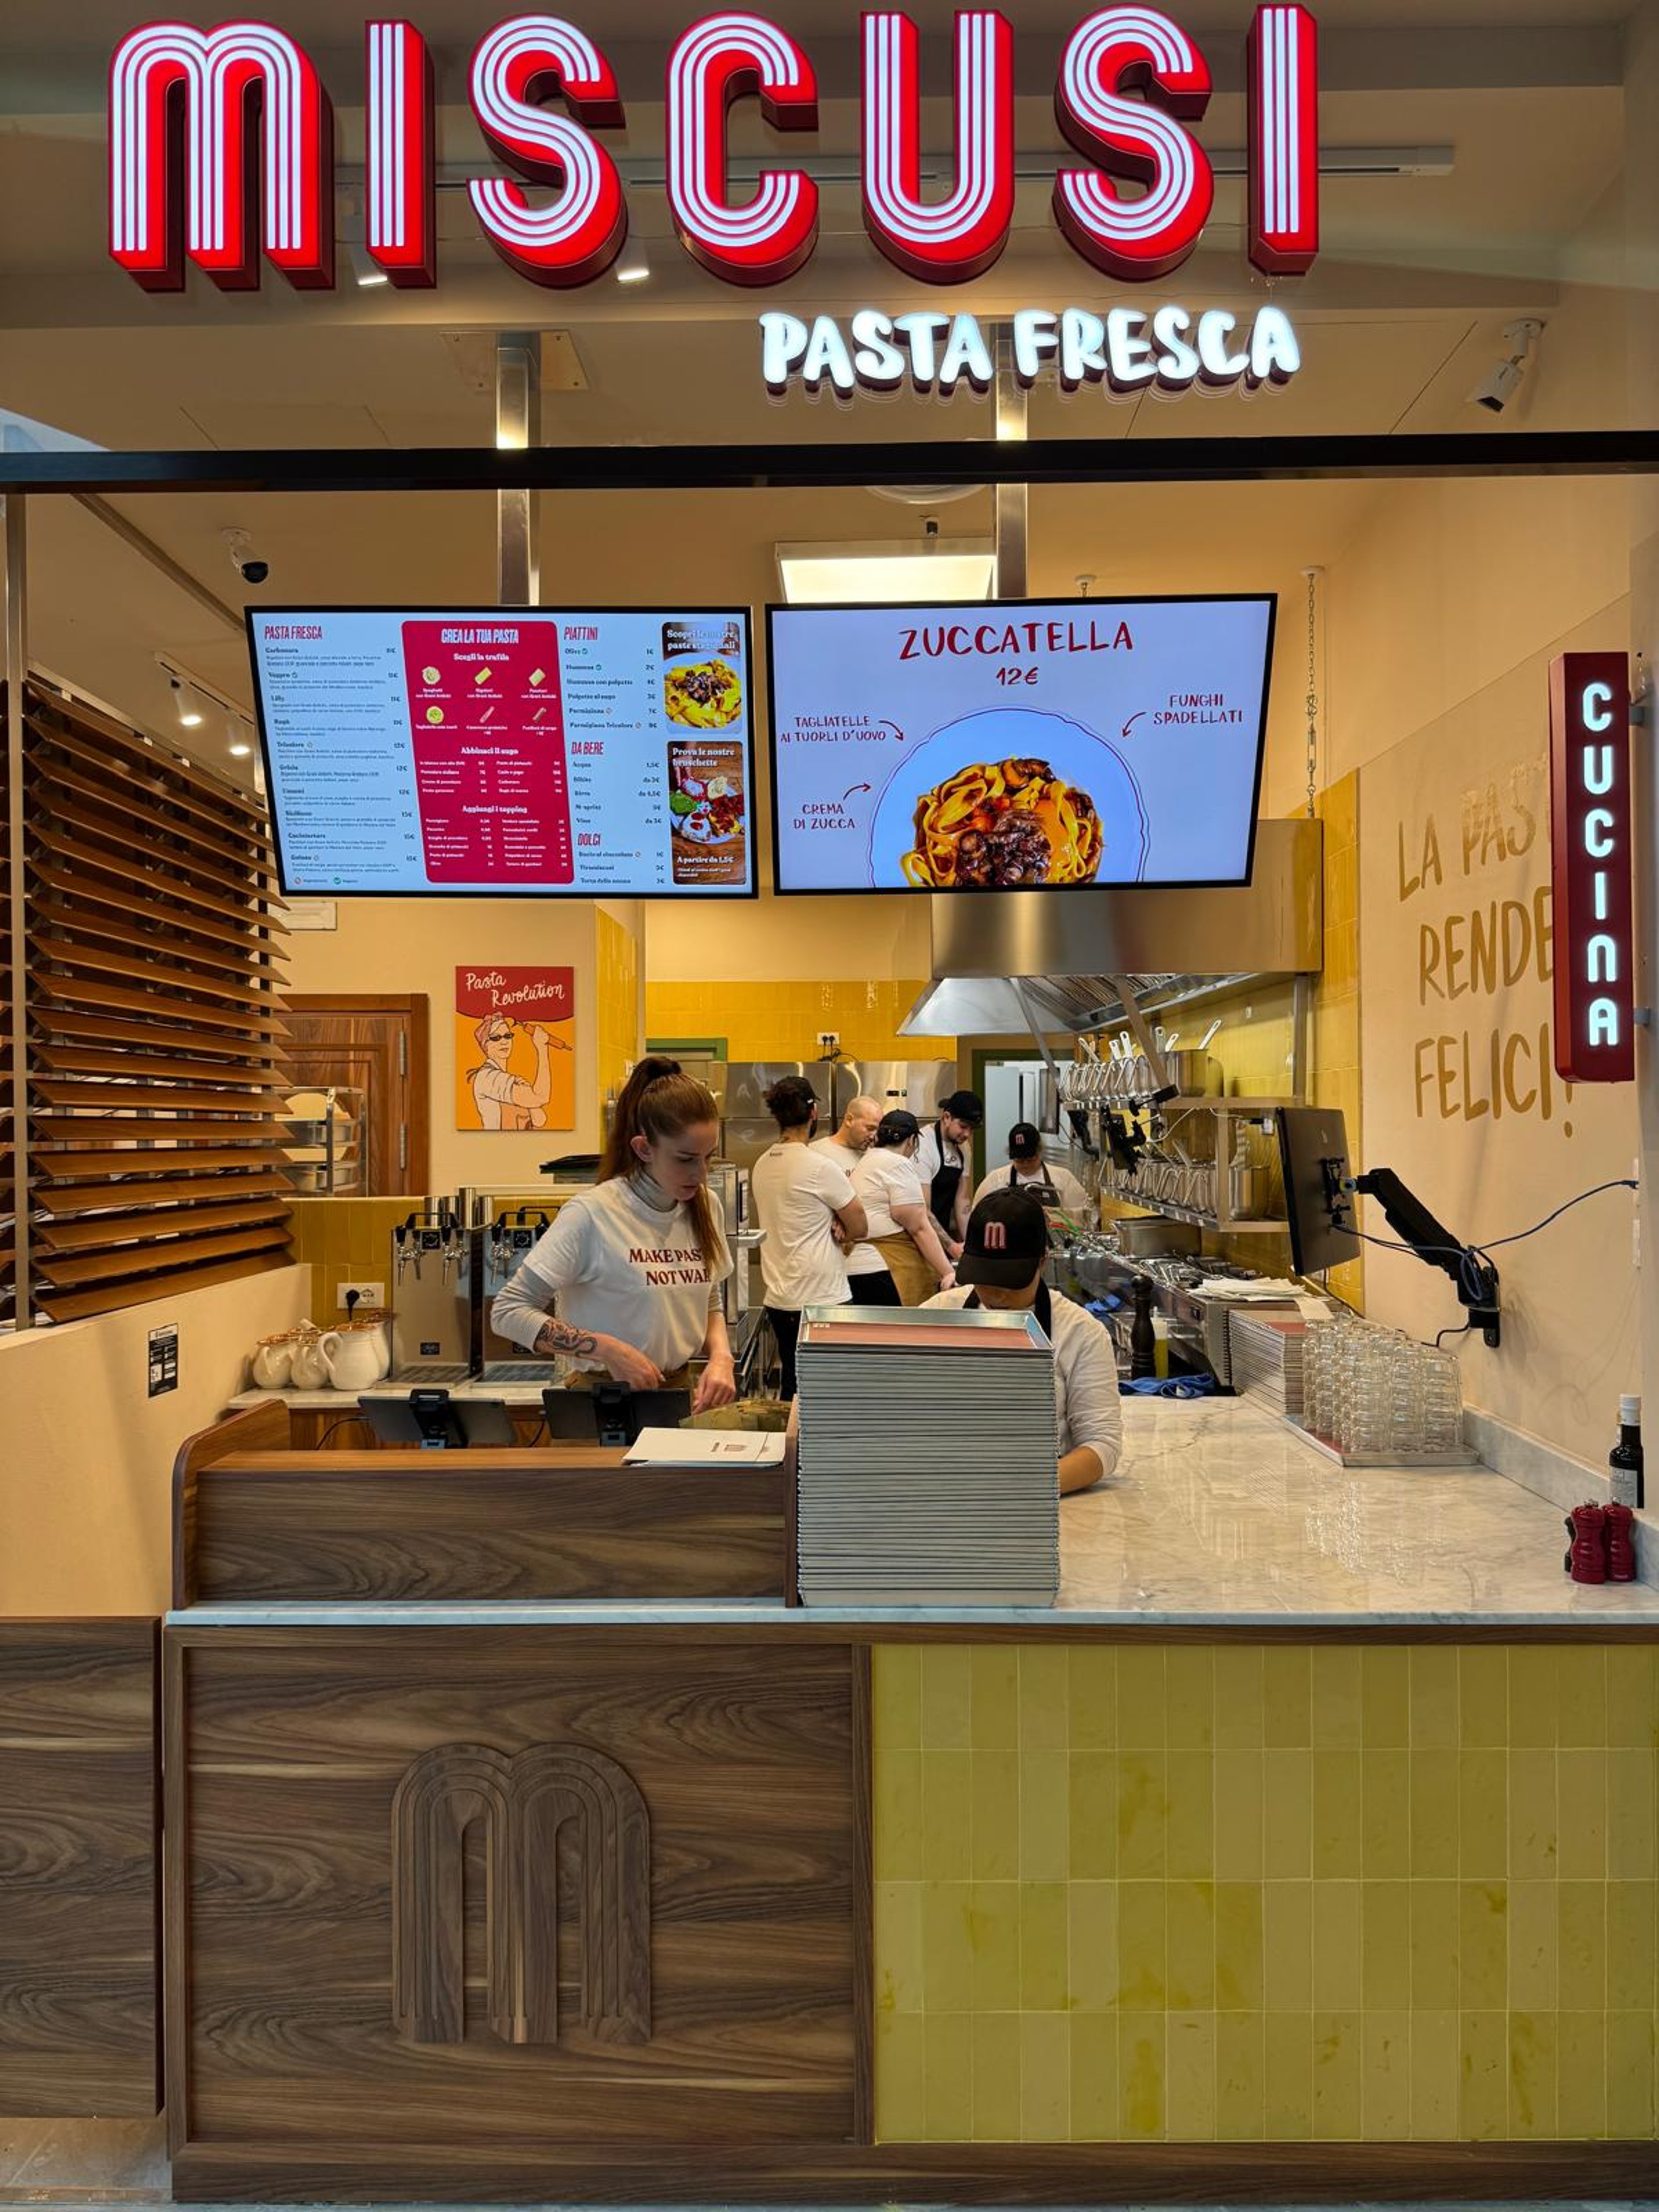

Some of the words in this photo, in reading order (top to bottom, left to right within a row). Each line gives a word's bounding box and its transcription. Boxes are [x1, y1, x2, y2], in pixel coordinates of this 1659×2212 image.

[108, 3, 1319, 292] MISCUSI
[759, 310, 994, 394] PASTA
[1014, 306, 1300, 391] FRESCA
[265, 626, 289, 640] PASTA
[291, 626, 322, 639] FRESCA
[441, 629, 462, 644] CREA
[464, 629, 474, 644] LA
[475, 629, 492, 644] TUA
[493, 629, 519, 644] PASTA
[564, 627, 597, 640] PIATTINI
[667, 630, 696, 639] Scopri
[899, 621, 1133, 660] ZUCCATELLA
[996, 667, 1039, 686] 12€
[1170, 694, 1223, 708] FUNGHI
[794, 715, 870, 728] TAGLIATELLE
[1154, 710, 1242, 725] SPADELLATI
[781, 733, 790, 742] AI
[794, 731, 838, 742] TUORLI
[571, 742, 582, 755] DA
[583, 742, 604, 755] BERE
[802, 803, 844, 815] CREMA
[794, 819, 805, 829] DI
[811, 818, 855, 829] ZUCCA
[1398, 812, 1443, 903] LA
[1460, 753, 1553, 876] PAS
[578, 833, 601, 846] DOLCI
[1583, 682, 1618, 1046] CUCINA
[1420, 886, 1554, 1007] RENDE
[466, 972, 506, 991] Pasta
[492, 982, 565, 1007] Revolution
[629, 1248, 674, 1263] MAKE
[674, 1249, 702, 1262] PAS
[646, 1271, 677, 1286] NOT
